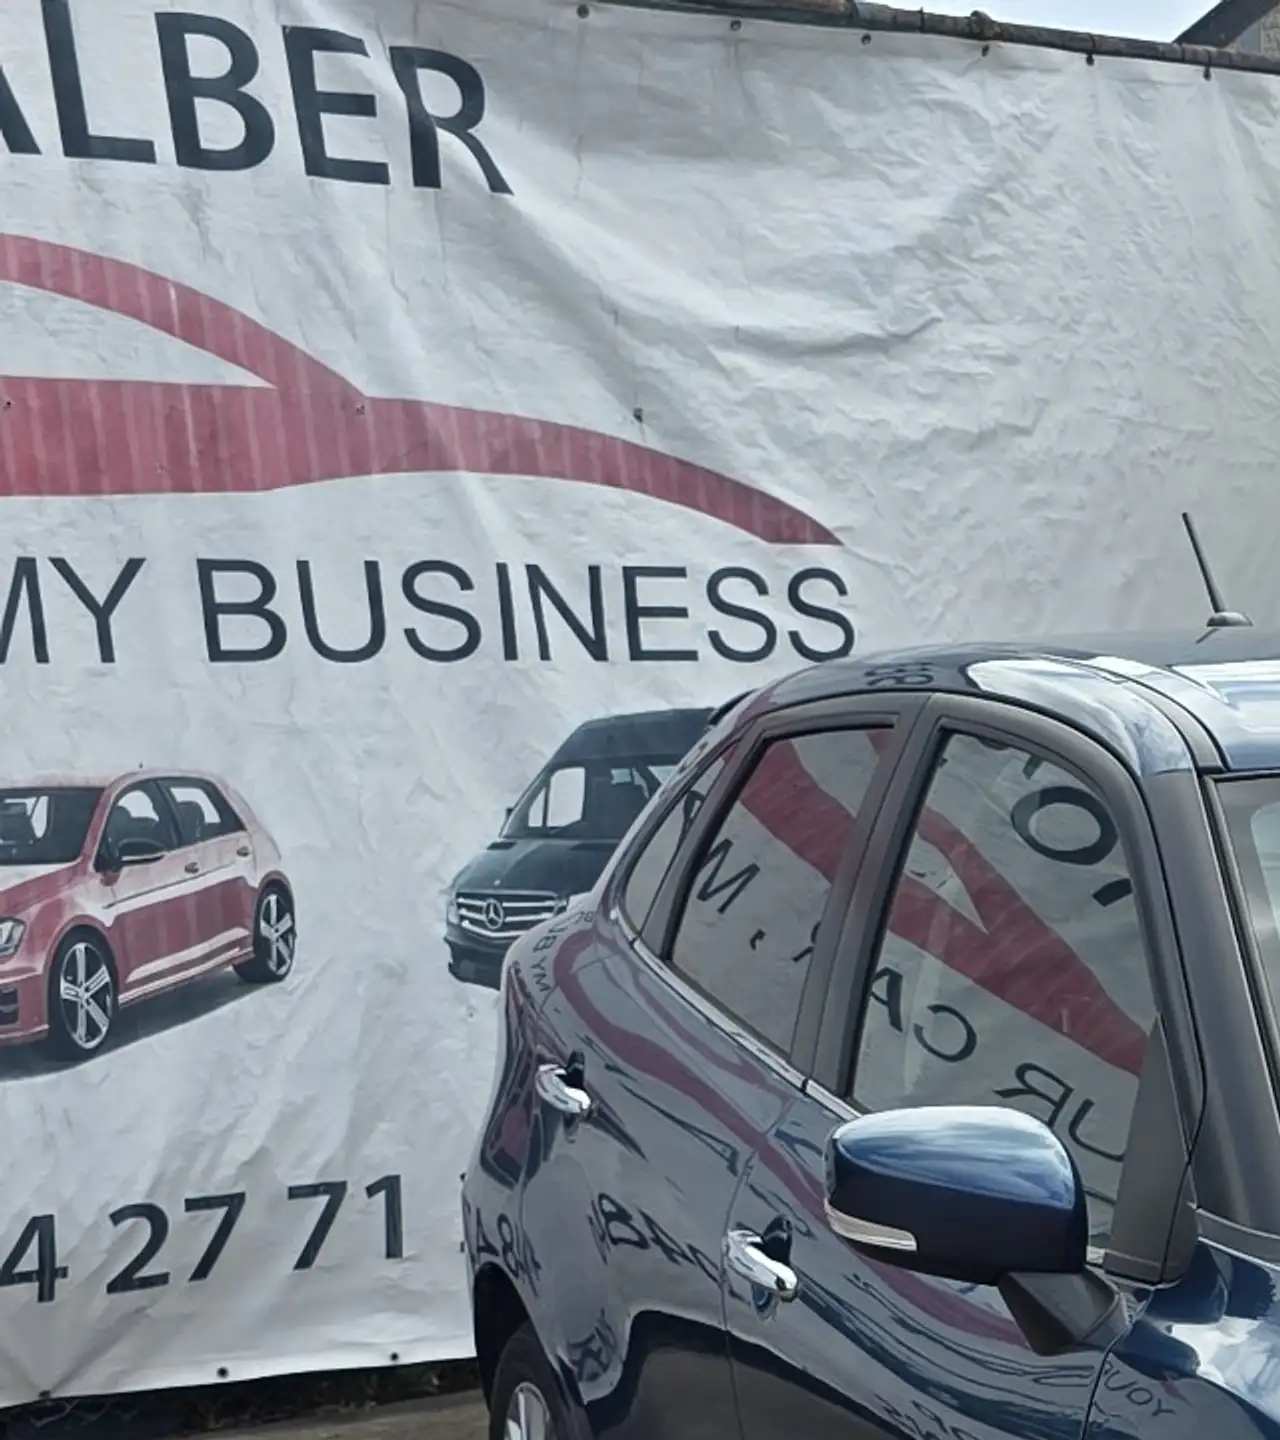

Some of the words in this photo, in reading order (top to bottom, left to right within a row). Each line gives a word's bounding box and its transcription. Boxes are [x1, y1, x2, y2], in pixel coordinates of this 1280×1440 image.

[196, 557, 856, 664] BUSINESS
[106, 1191, 247, 1295] 27
[287, 1173, 404, 1271] 71
